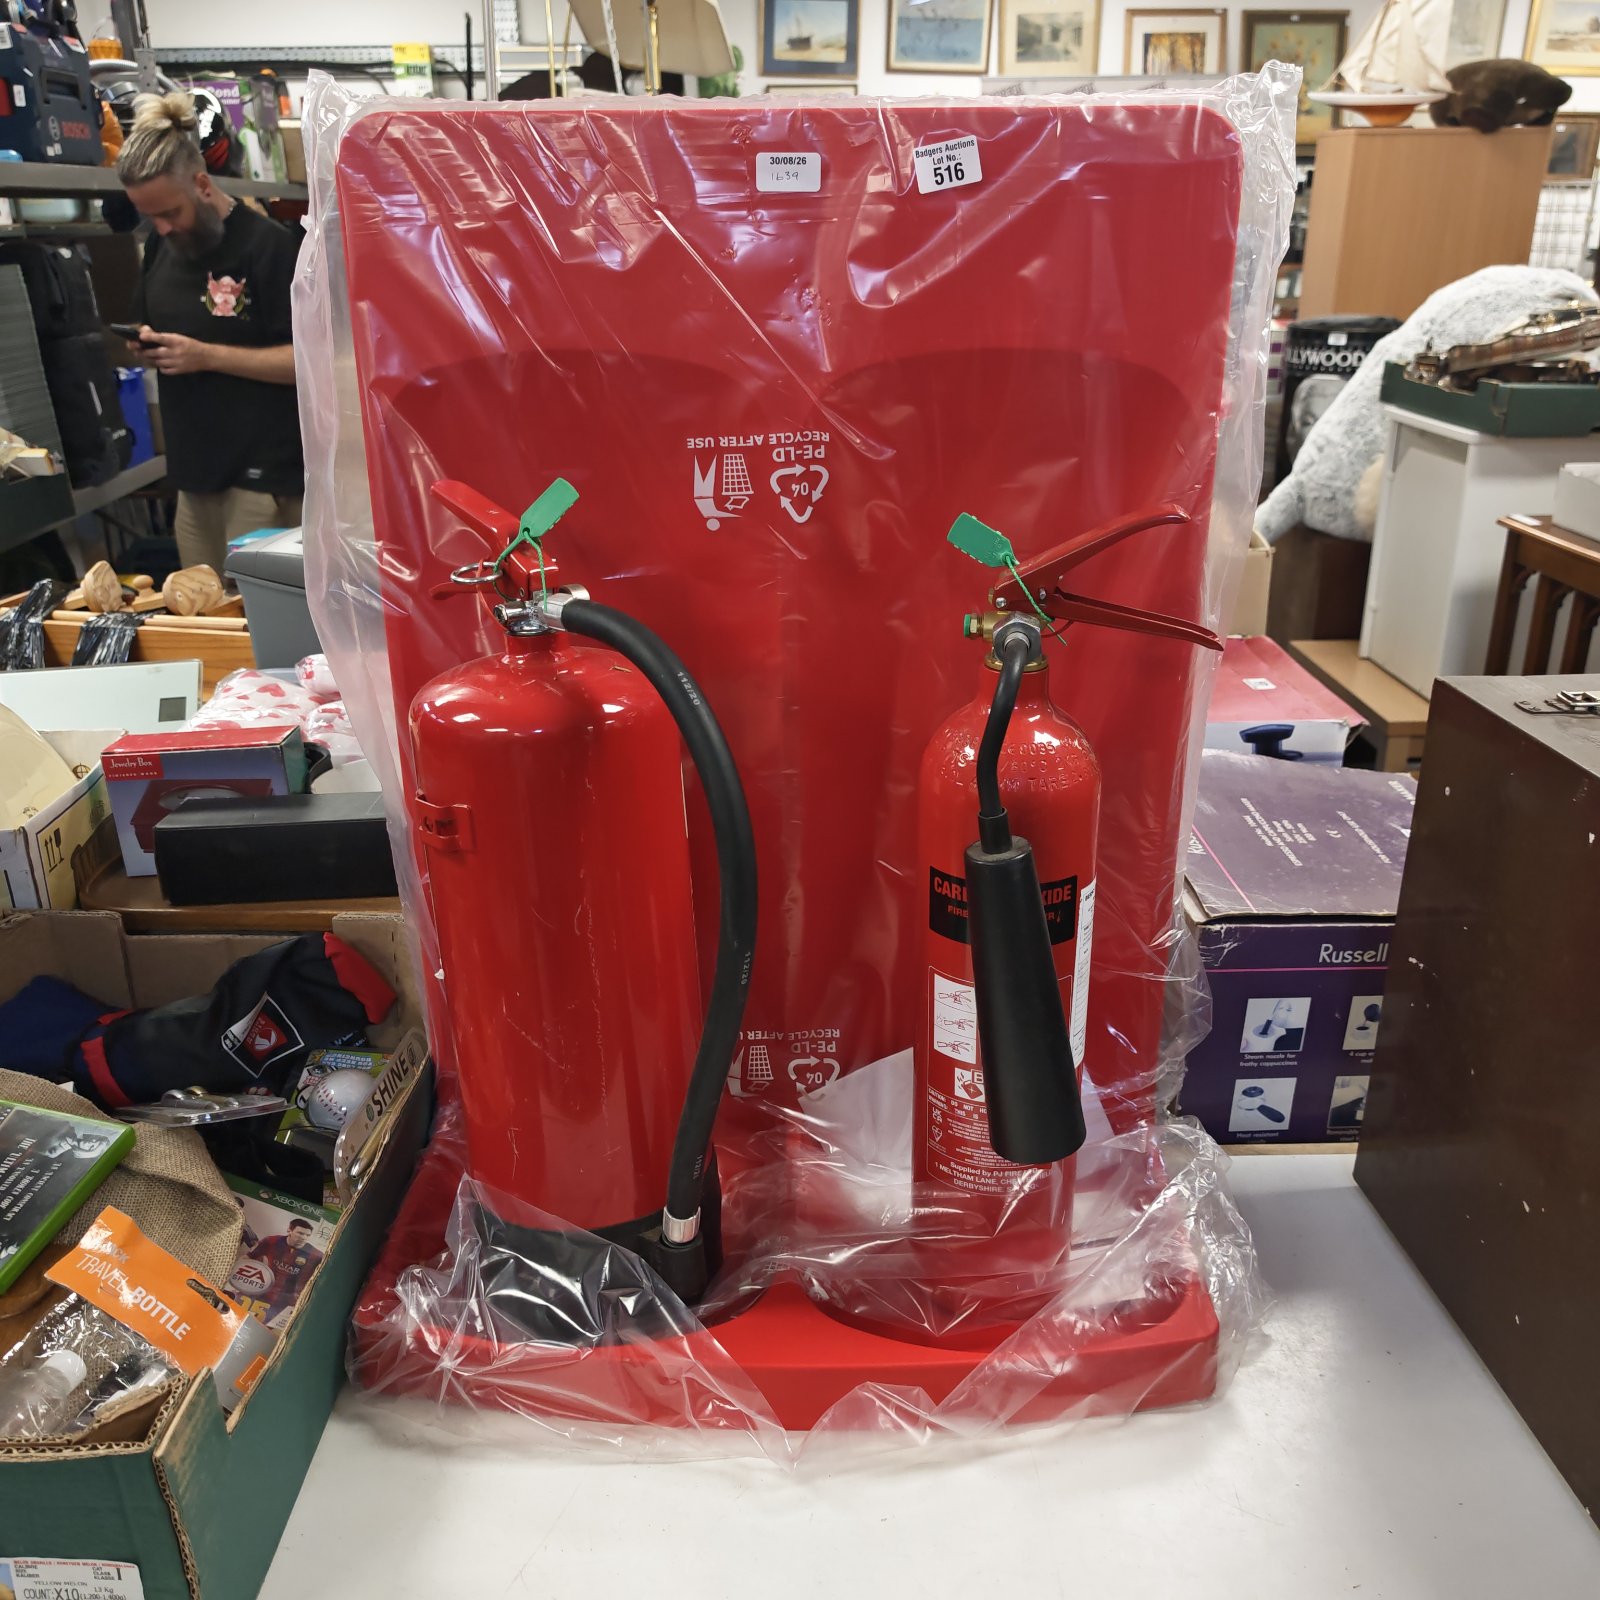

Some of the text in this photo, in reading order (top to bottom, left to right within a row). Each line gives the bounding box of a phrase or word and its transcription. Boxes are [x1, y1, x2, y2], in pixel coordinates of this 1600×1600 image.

[915, 138, 975, 160] Badgers Auctions
[769, 156, 807, 166] 30/08/26
[932, 156, 945, 166] Lot
[771, 172, 799, 182] 1639
[933, 162, 965, 186] 516
[687, 430, 830, 449] RECYCLE AFTER USE
[772, 444, 826, 463] PE-LD
[791, 481, 809, 498] 04
[677, 671, 700, 706] 112/20
[110, 756, 153, 769] Jewelry Box
[934, 876, 968, 902] CAR
[1318, 943, 1389, 963] Russell
[747, 1030, 784, 1041] AFTER
[788, 1028, 840, 1041] RECYCLE
[791, 1040, 836, 1053] PE-LD
[371, 1056, 410, 1117] SHINE
[805, 1072, 823, 1085] 04
[18, 1137, 37, 1151] THE
[939, 1164, 974, 1182] MELTHAM
[950, 1161, 981, 1175] Supplied
[982, 1169, 991, 1178] by
[993, 1170, 1003, 1178] PJ
[273, 1193, 325, 1217] XBOX ONE
[236, 1264, 266, 1284] EA
[273, 1259, 300, 1274] QATAR
[231, 1273, 266, 1290] SPORTS
[76, 1252, 130, 1293] TRAVEL
[129, 1286, 192, 1342] BOTTLE
